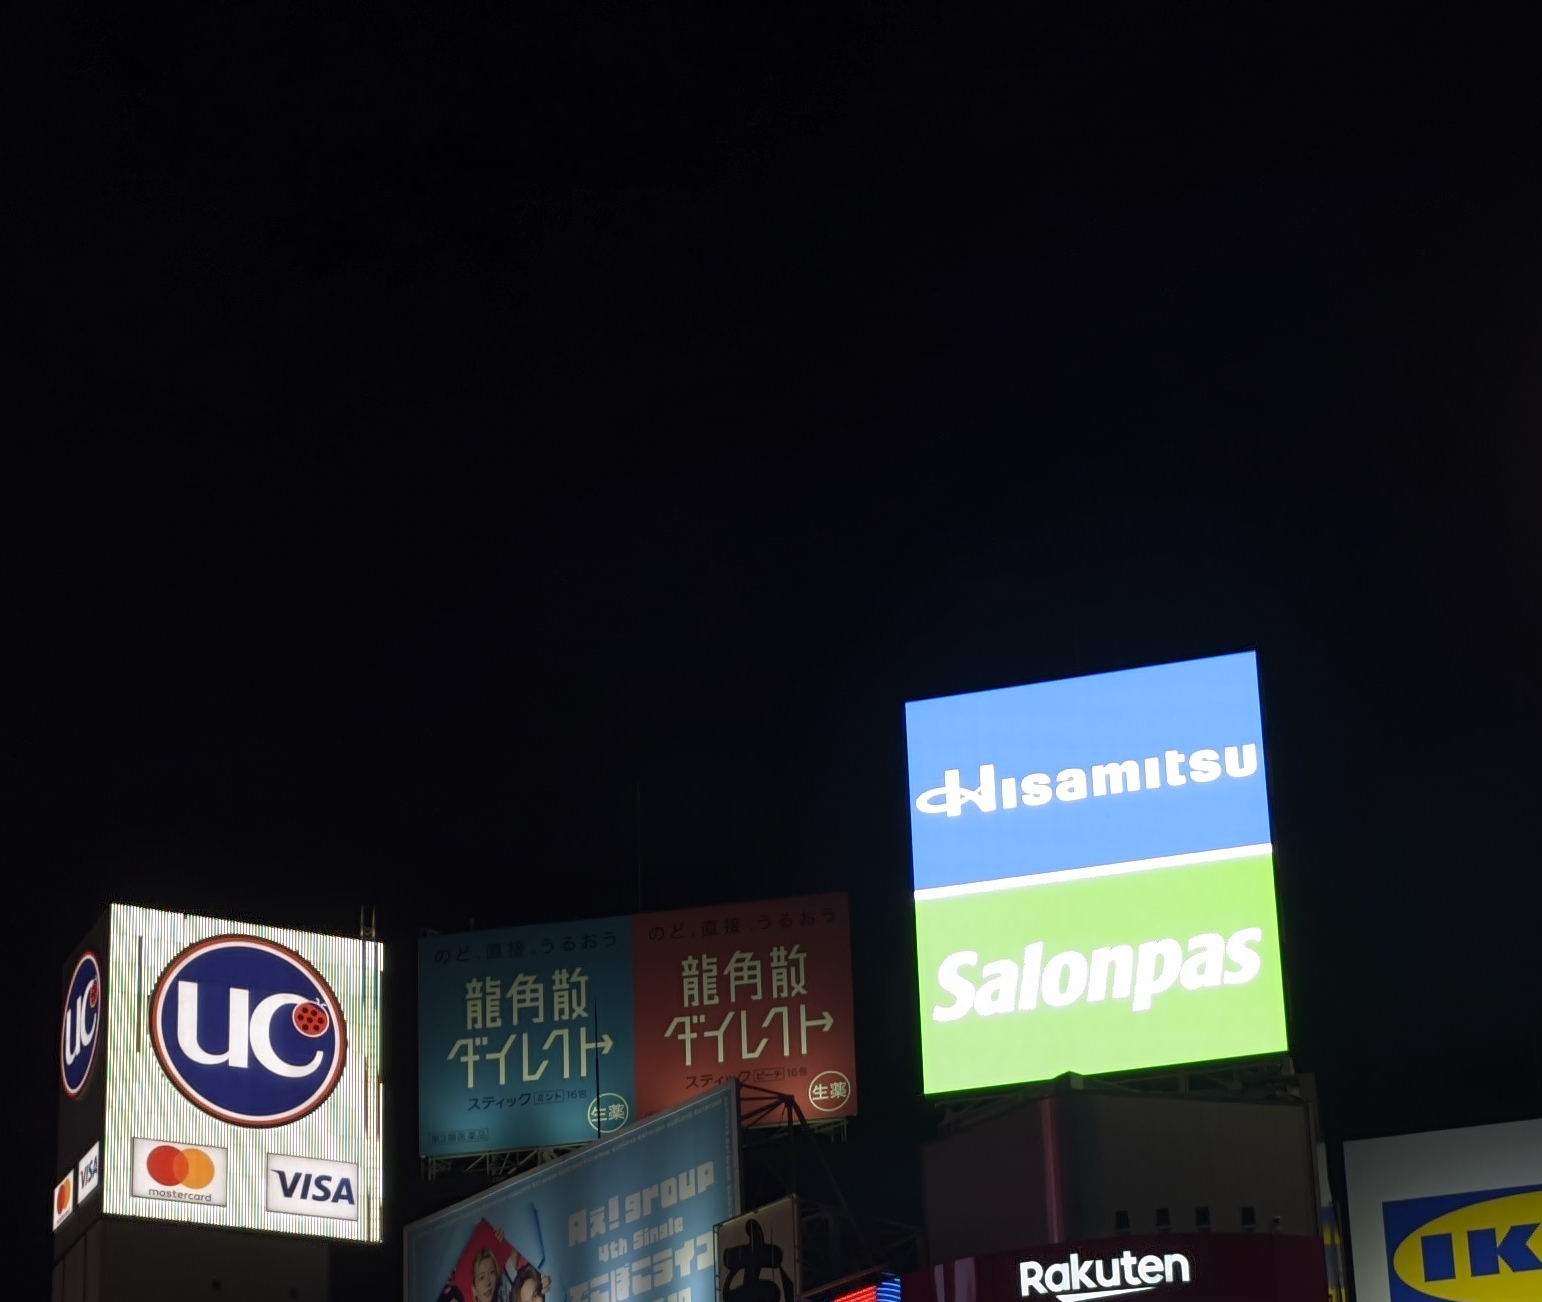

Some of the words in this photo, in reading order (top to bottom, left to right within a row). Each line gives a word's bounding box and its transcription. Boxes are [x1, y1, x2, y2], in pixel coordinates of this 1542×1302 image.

[916, 743, 1258, 816] Hisamitsu
[681, 943, 808, 1008] 龍角散
[932, 927, 1262, 1023] Salonpas
[465, 967, 590, 1030] 龍角散
[447, 1025, 614, 1089] ダイレクト
[664, 1005, 834, 1066] ダイレクト
[754, 1068, 785, 1082] ピーチ
[811, 1081, 847, 1101] 生薬
[468, 1092, 532, 1112] スティック
[535, 1090, 565, 1104] ミント
[591, 1103, 626, 1122] 生薬
[80, 1156, 98, 1188] VISA
[271, 1168, 356, 1207] VISA
[148, 1188, 212, 1203] mastercard
[598, 1238, 628, 1262] 4th
[633, 1216, 684, 1250] Single
[1020, 1249, 1191, 1300] Rakuten
